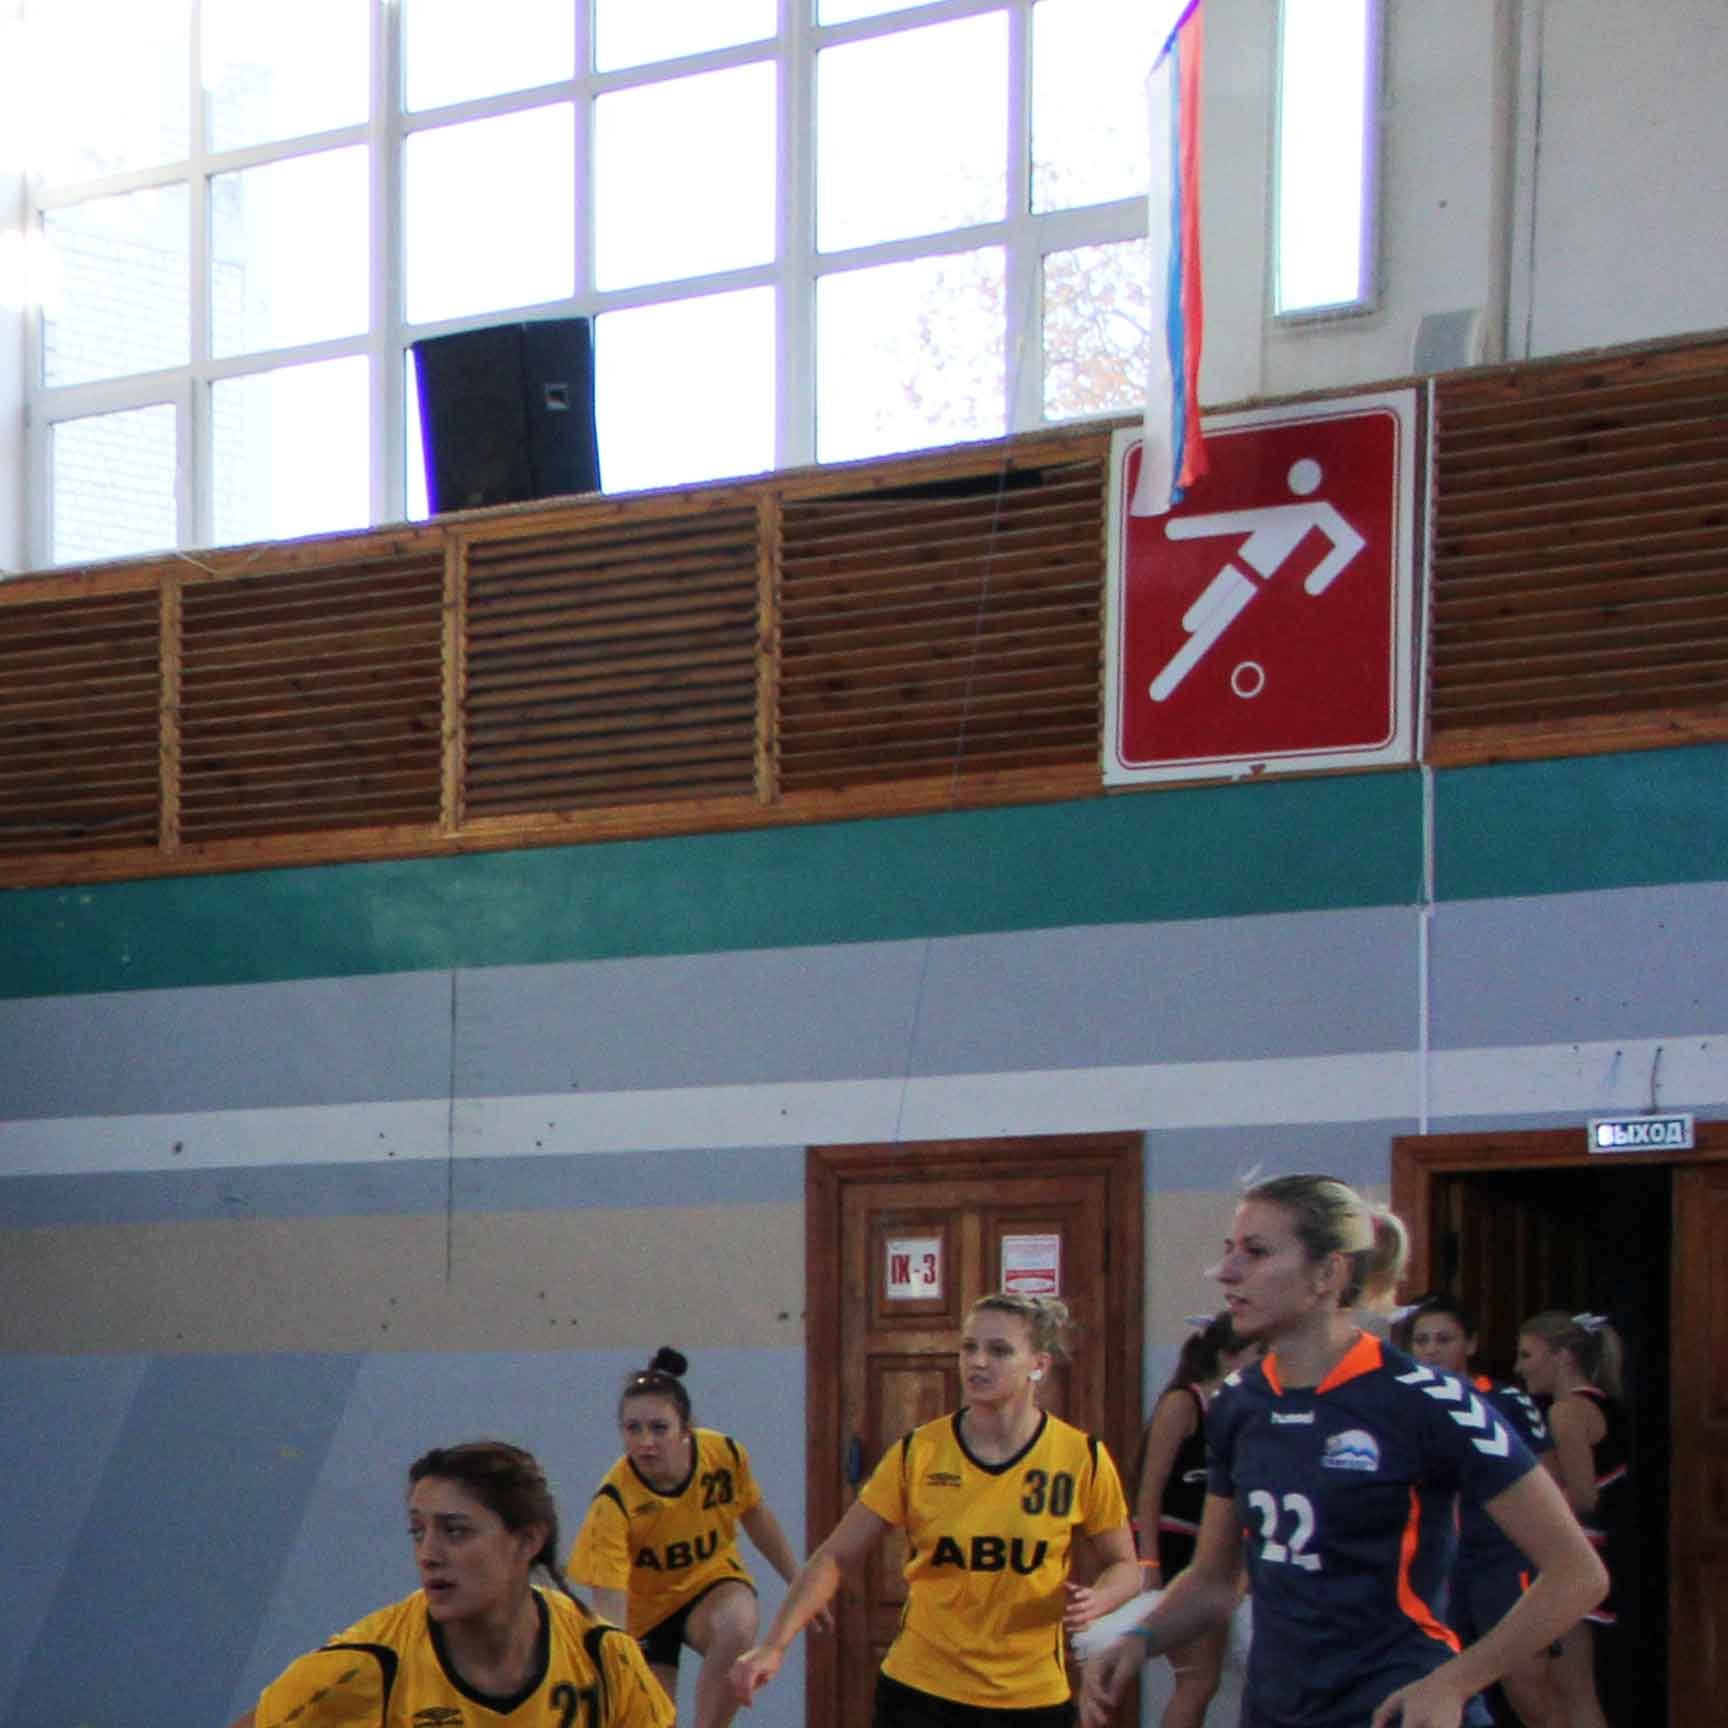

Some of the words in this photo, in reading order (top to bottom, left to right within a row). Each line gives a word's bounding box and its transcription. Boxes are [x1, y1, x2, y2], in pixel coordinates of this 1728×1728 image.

[700, 1467, 734, 1510] 23
[1023, 1469, 1074, 1517] 30
[635, 1529, 718, 1571] ABU
[1248, 1489, 1323, 1571] 22
[931, 1536, 1048, 1575] ABU
